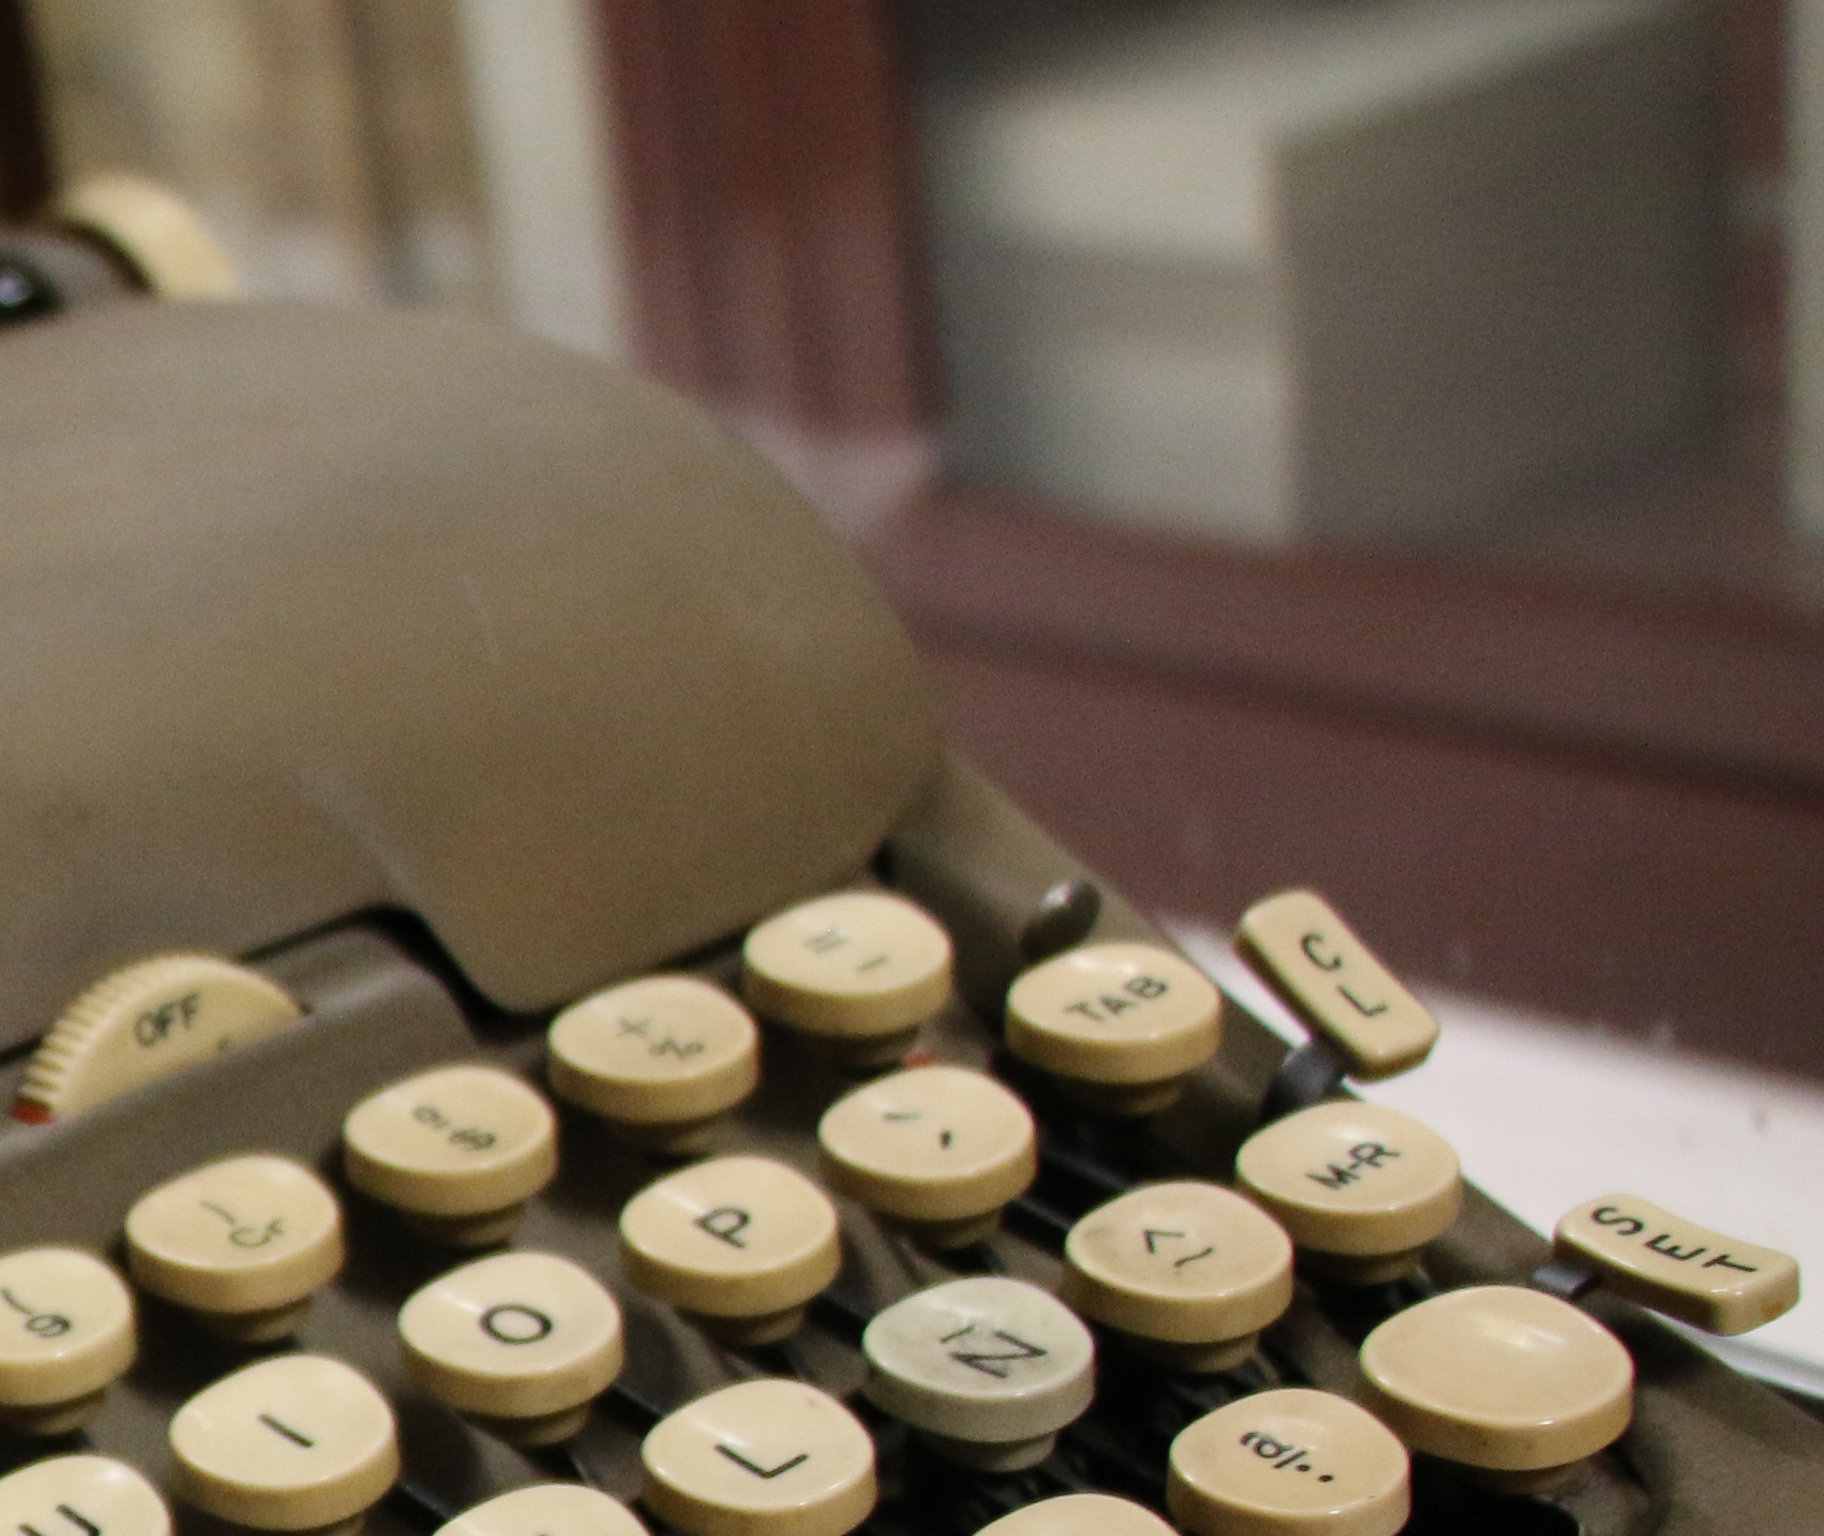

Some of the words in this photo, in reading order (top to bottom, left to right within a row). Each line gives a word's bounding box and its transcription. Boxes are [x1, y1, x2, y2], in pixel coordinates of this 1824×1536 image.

[132, 990, 201, 1049] OFF
[1062, 975, 1170, 1023] TAB
[1306, 1143, 1401, 1191] M-R
[693, 1205, 752, 1249] P
[1592, 1204, 1759, 1275] SET
[26, 1314, 73, 1338] 9
[479, 1304, 554, 1346] O
[261, 1414, 315, 1449] I
[715, 1444, 809, 1480] L
